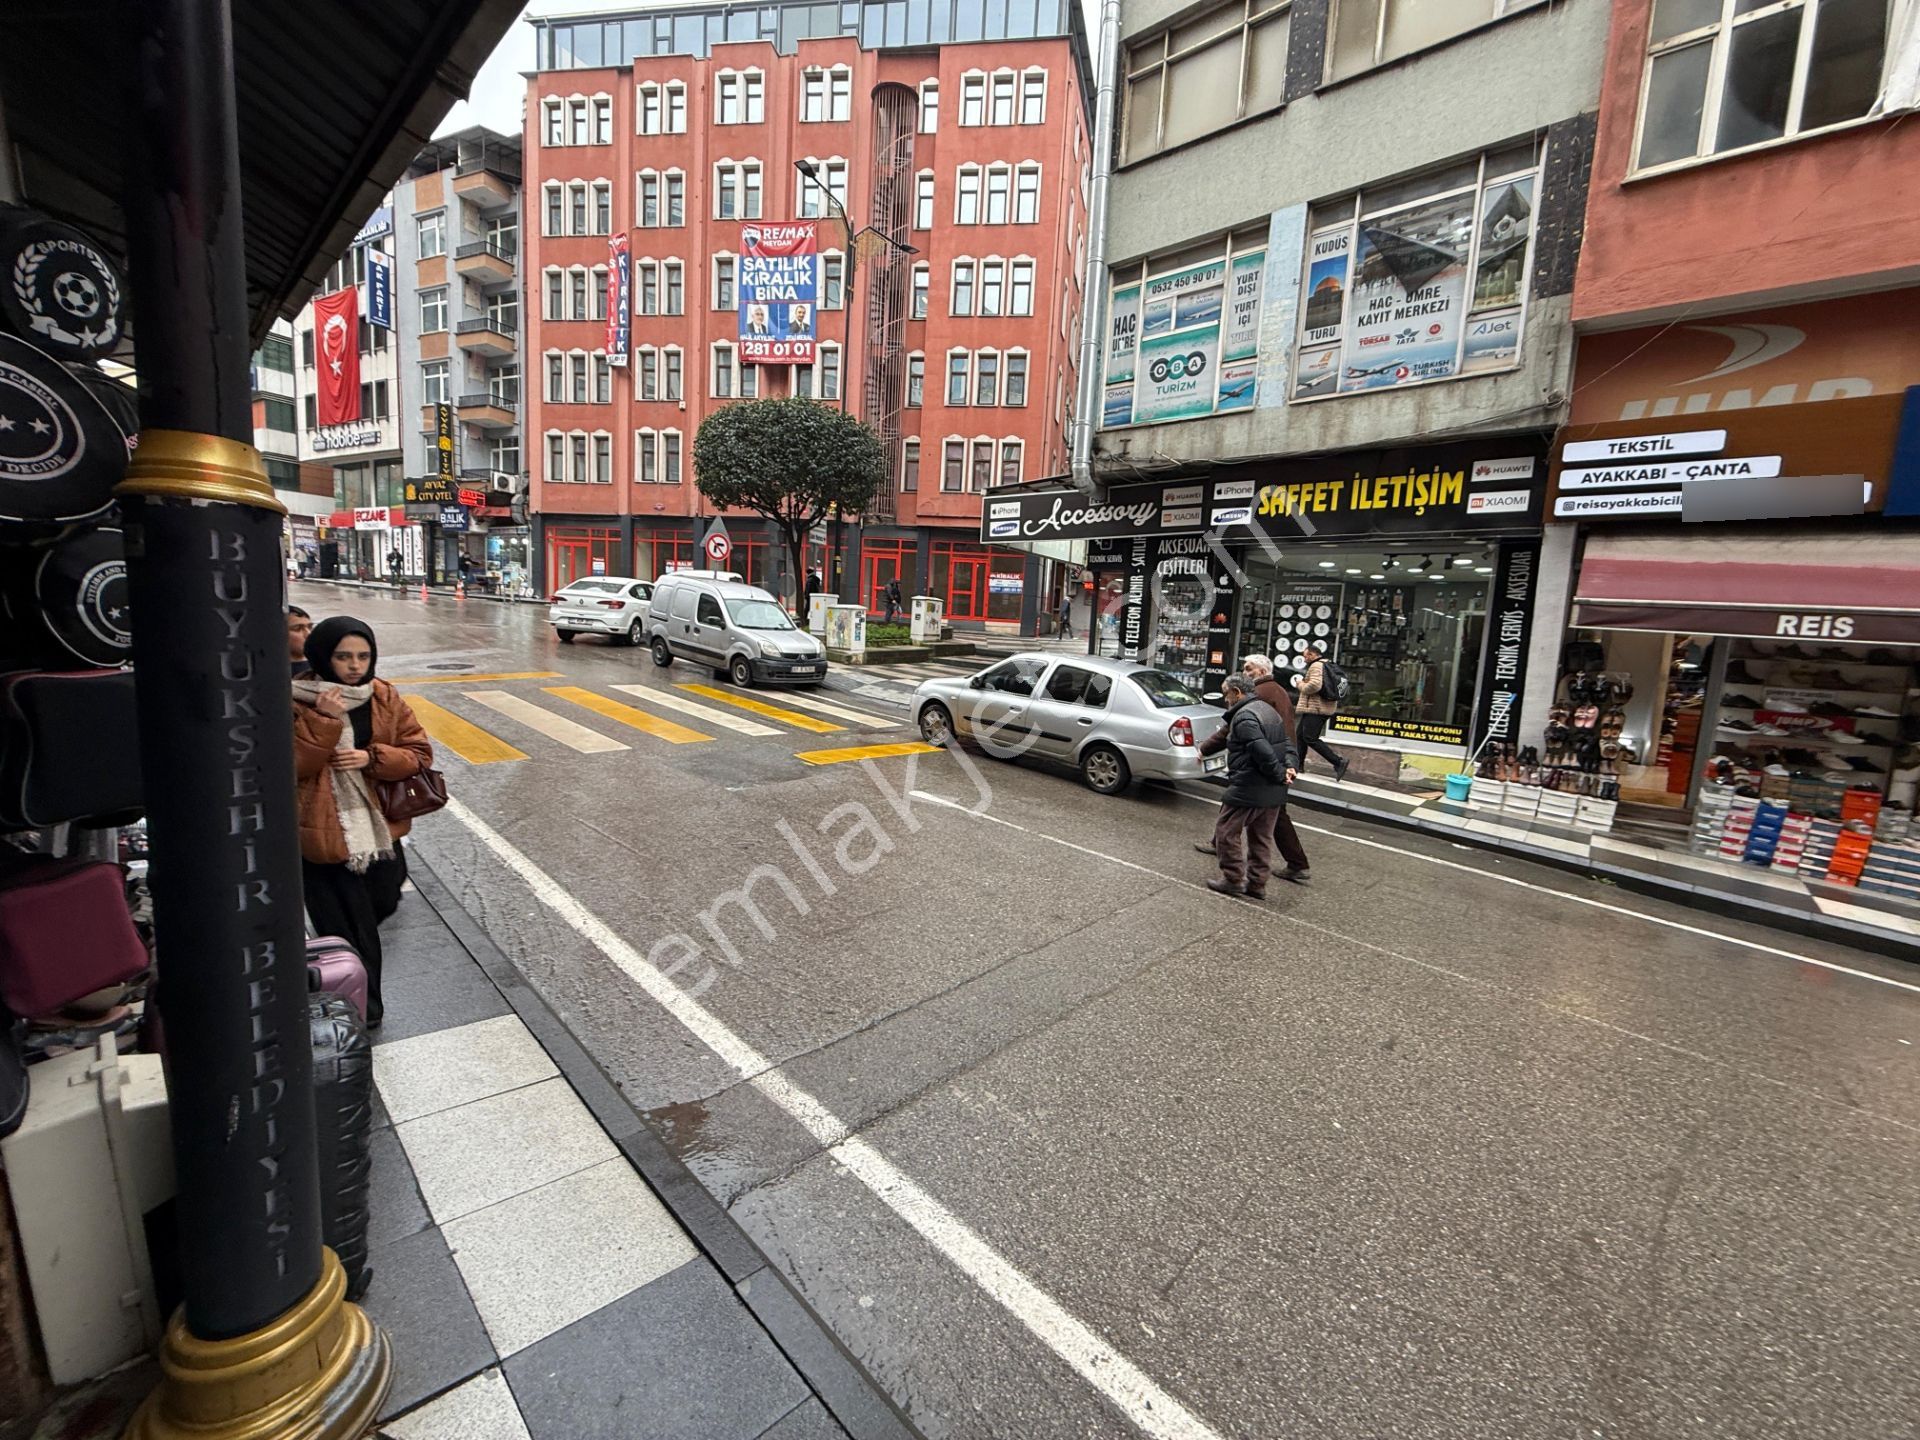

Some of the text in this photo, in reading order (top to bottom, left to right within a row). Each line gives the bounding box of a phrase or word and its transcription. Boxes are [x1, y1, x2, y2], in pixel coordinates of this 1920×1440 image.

[763, 227, 815, 240] RE/MAX
[36, 240, 95, 259] SPORTS
[1315, 235, 1348, 255] KUDÜS
[743, 256, 812, 272] SATILIK
[375, 264, 383, 281] AK
[1236, 271, 1260, 285] YURT
[1152, 269, 1217, 295] 0532 450 90 07
[1234, 300, 1258, 313] YURT
[1369, 296, 1393, 311] HAC
[1357, 296, 1450, 327] KAYIT MERKEZİ
[1113, 313, 1136, 336] HAC
[1310, 326, 1336, 341] TURU
[745, 342, 769, 355] 281
[773, 343, 790, 356] 01
[794, 343, 811, 355] 01
[1412, 366, 1449, 377] AIRLINES
[1413, 360, 1449, 370] TURKISH
[1156, 380, 1197, 395] TURİZM
[1608, 436, 1675, 454] TEKSTİL
[6, 454, 66, 474] DECIDE
[1492, 464, 1531, 474] HUAWEI
[1581, 468, 1666, 485] AYAKKABI
[1686, 462, 1751, 481] ÇANTA
[425, 481, 446, 489] AYVAZ
[1223, 485, 1253, 496] iPhone
[1258, 465, 1465, 517] SAFFET İLETİŞİM
[418, 491, 434, 501] CITY
[1176, 492, 1201, 500] HUAWEI
[1485, 496, 1527, 507] XIAOMI
[356, 509, 387, 522] ECZANE
[440, 513, 466, 523] BALIK
[997, 506, 1019, 515] iPhone
[1023, 498, 1157, 536] Accessory
[1173, 512, 1200, 521] XIAOMI
[1216, 511, 1247, 521] SAMSUNG
[320, 517, 327, 525] E
[1157, 556, 1209, 577] ÇEŞİTLERİ
[1506, 551, 1532, 601] AKSESUAR
[1128, 575, 1144, 605] ALINIR
[1125, 607, 1141, 644] TELEFON
[1500, 610, 1525, 643] SERVİS
[1125, 646, 1138, 657] EL
[1495, 644, 1520, 681] TEKNİK
[1487, 690, 1512, 739] TELEFONU
[1336, 715, 1355, 724] SIFIR
[1393, 721, 1402, 729] EL
[1403, 723, 1418, 731] CEP
[1420, 725, 1462, 735] TELEFONU
[1335, 723, 1359, 732] ALINIR
[1365, 726, 1394, 736] SATILIR
[1400, 731, 1426, 740] TAKAS
[1428, 735, 1462, 744] YAPILIR
[240, 941, 290, 1277] BELEDİYESİ
